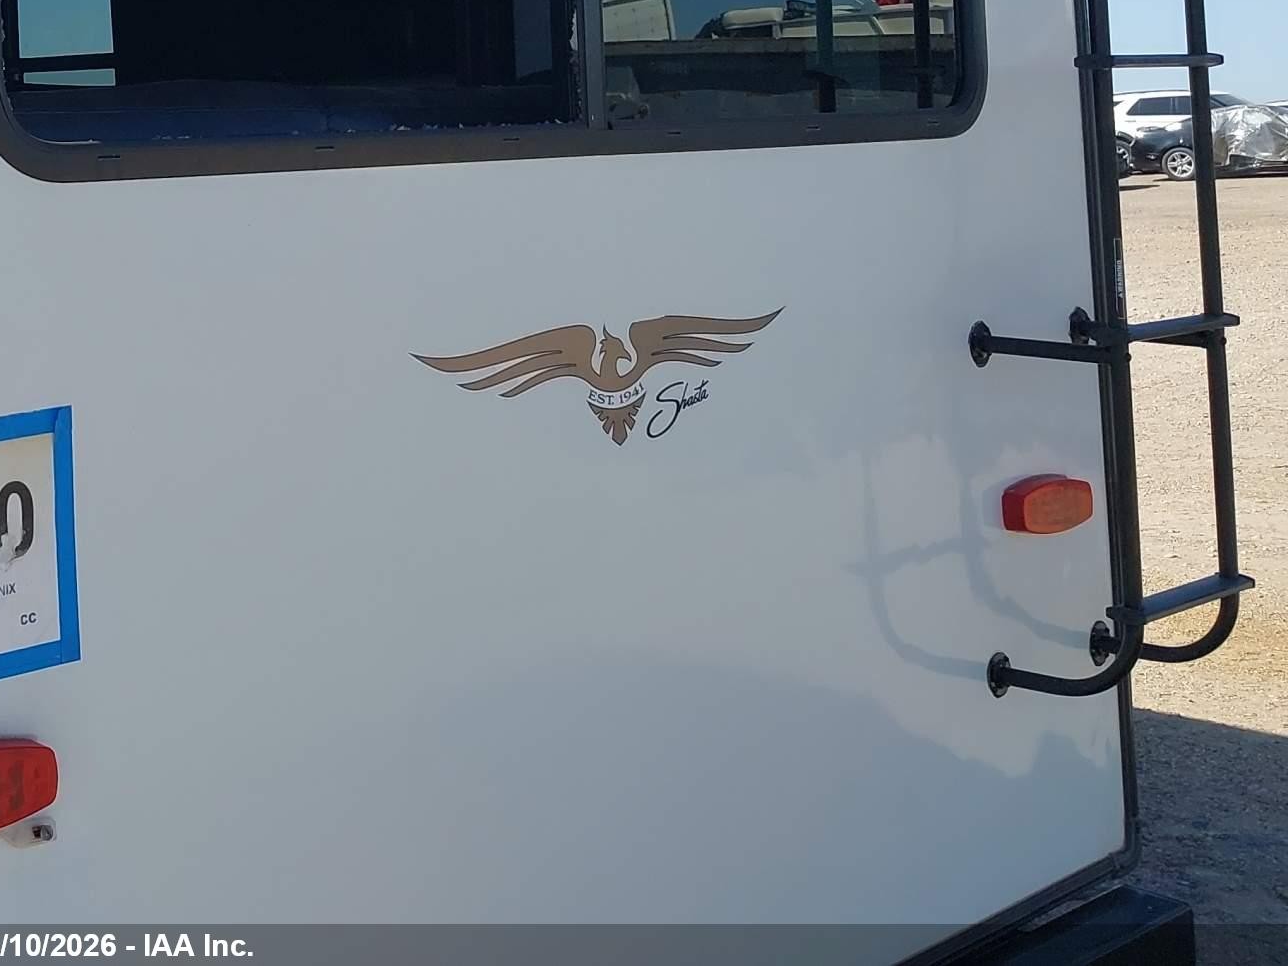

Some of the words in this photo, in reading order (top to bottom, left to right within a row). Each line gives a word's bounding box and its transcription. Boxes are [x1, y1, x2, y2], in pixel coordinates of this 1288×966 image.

[588, 390, 614, 405] EST.
[618, 381, 644, 403] 1941
[647, 379, 710, 438] Shasta
[20, 612, 37, 625] CC
